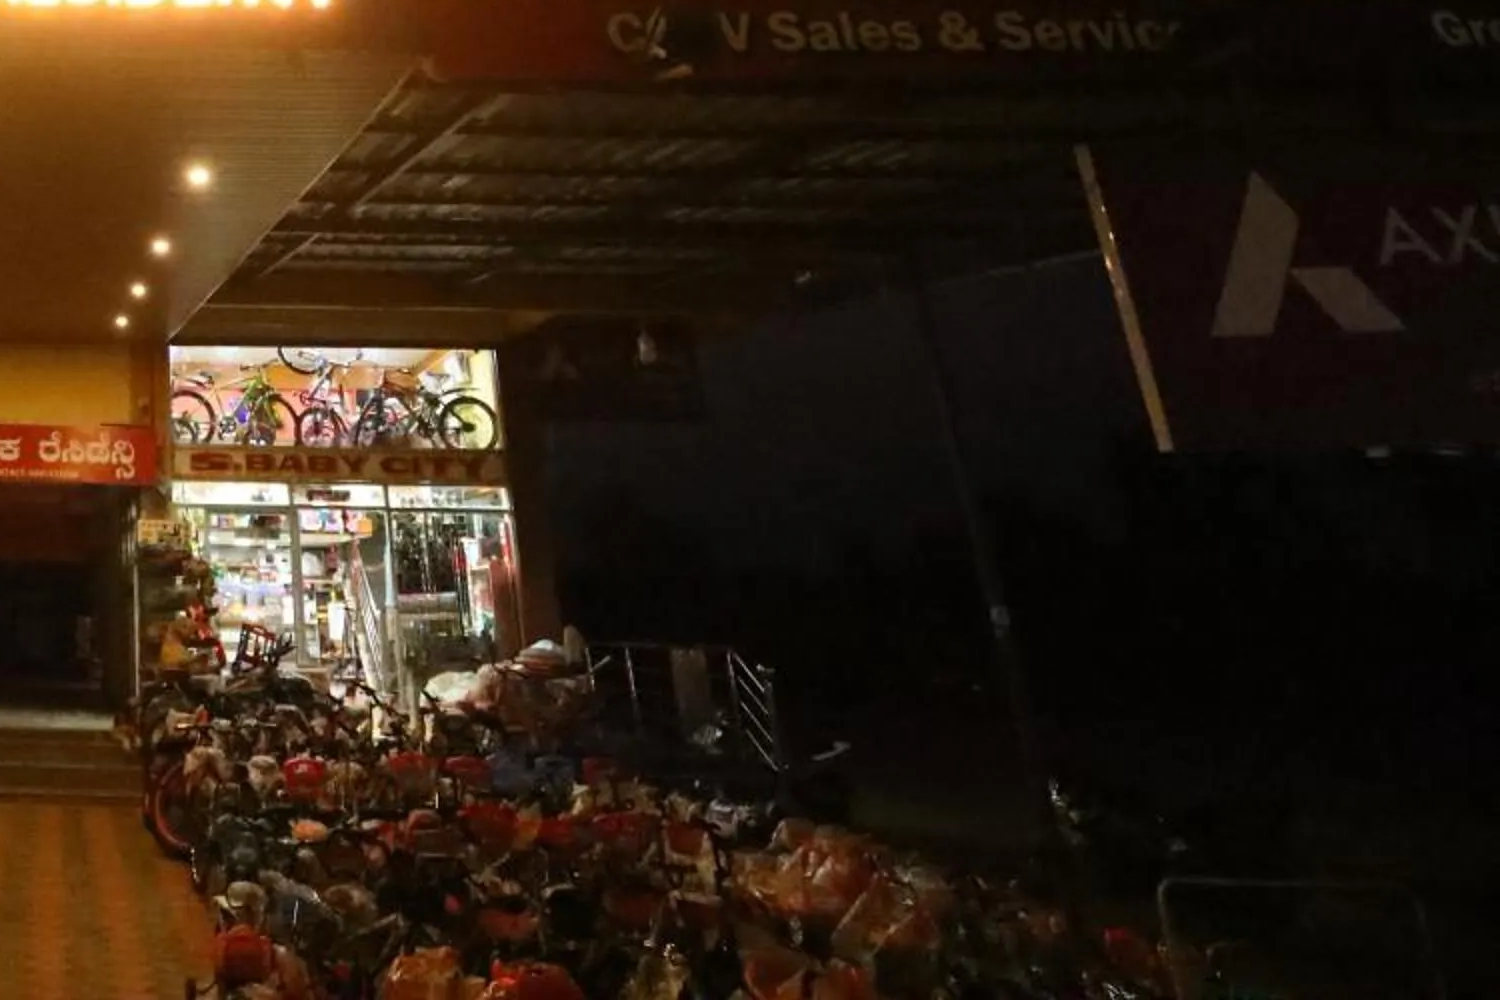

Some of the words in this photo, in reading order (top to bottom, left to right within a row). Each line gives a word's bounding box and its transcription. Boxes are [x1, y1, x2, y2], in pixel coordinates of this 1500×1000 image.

[768, 11, 922, 52] Sales
[938, 10, 985, 53] &
[997, 10, 1182, 53] Servic
[380, 457, 482, 476] CITY
